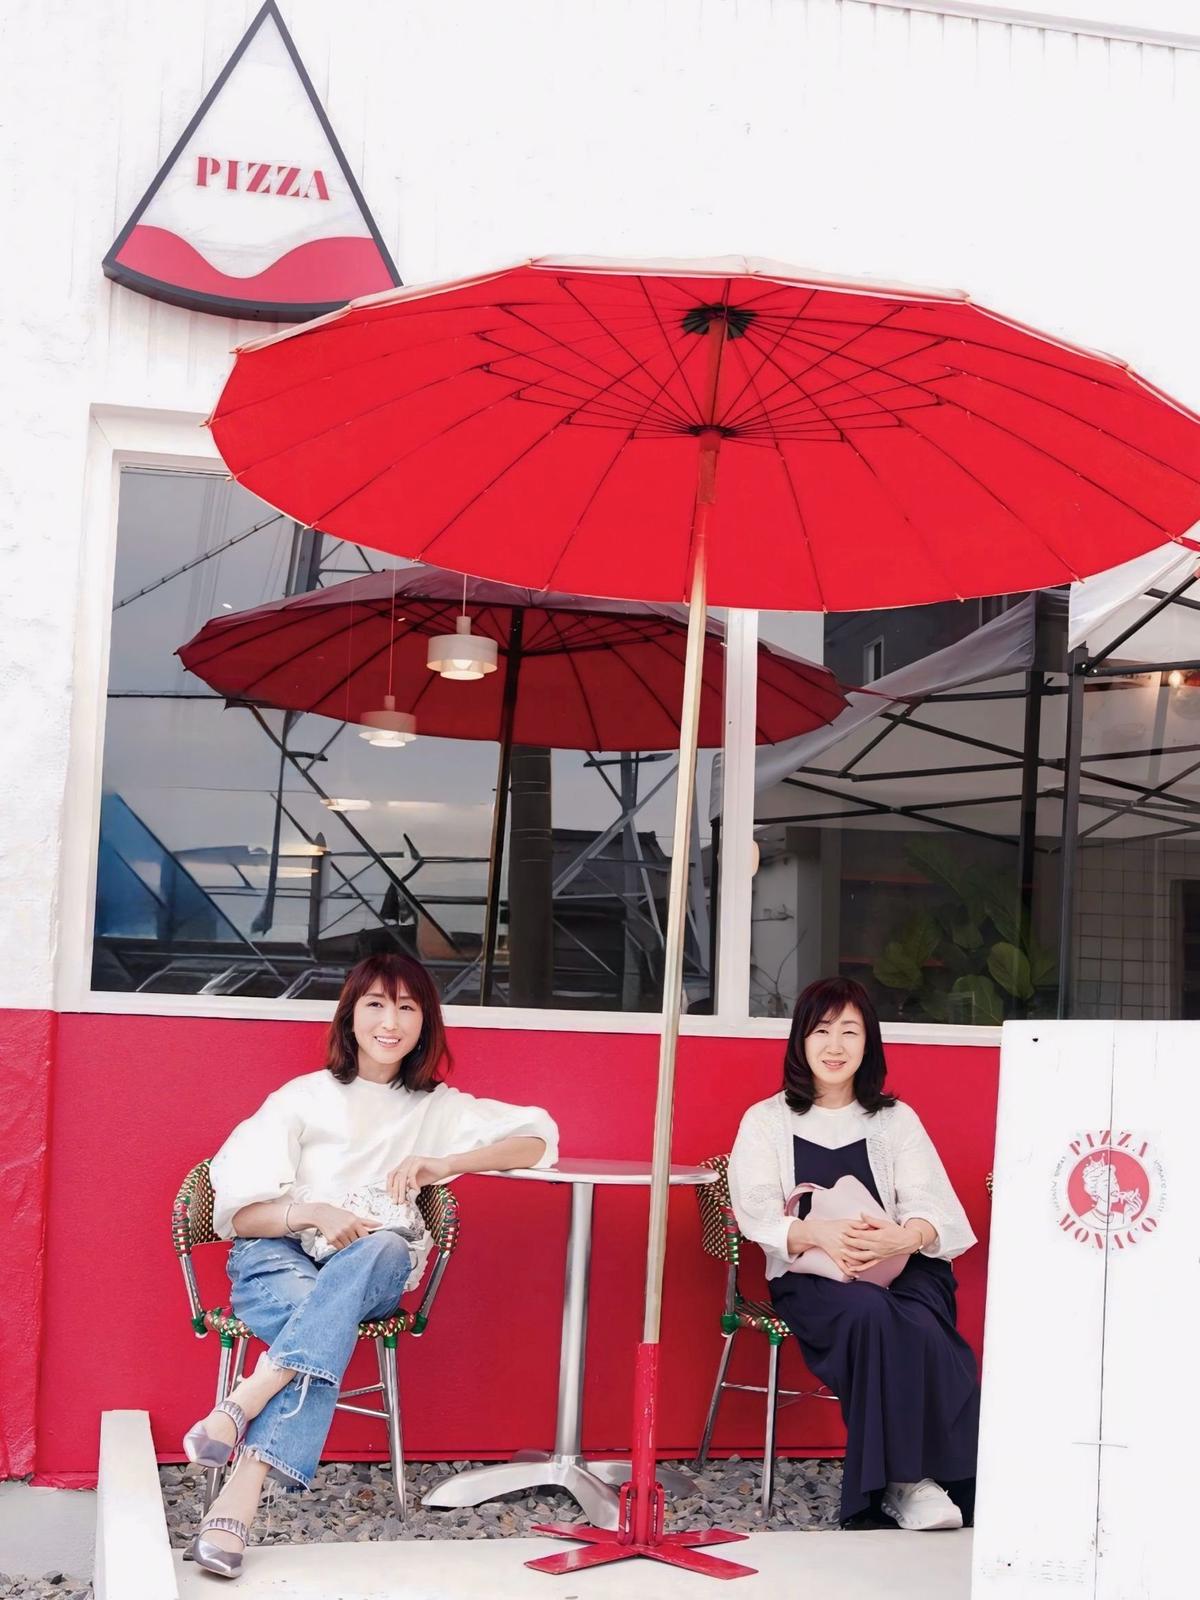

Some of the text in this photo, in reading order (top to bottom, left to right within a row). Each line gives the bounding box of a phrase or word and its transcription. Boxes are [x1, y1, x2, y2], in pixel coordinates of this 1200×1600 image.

[196, 156, 331, 200] PIZZA
[1069, 1130, 1148, 1158] PIZZA
[1057, 1213, 1158, 1249] MONACO
